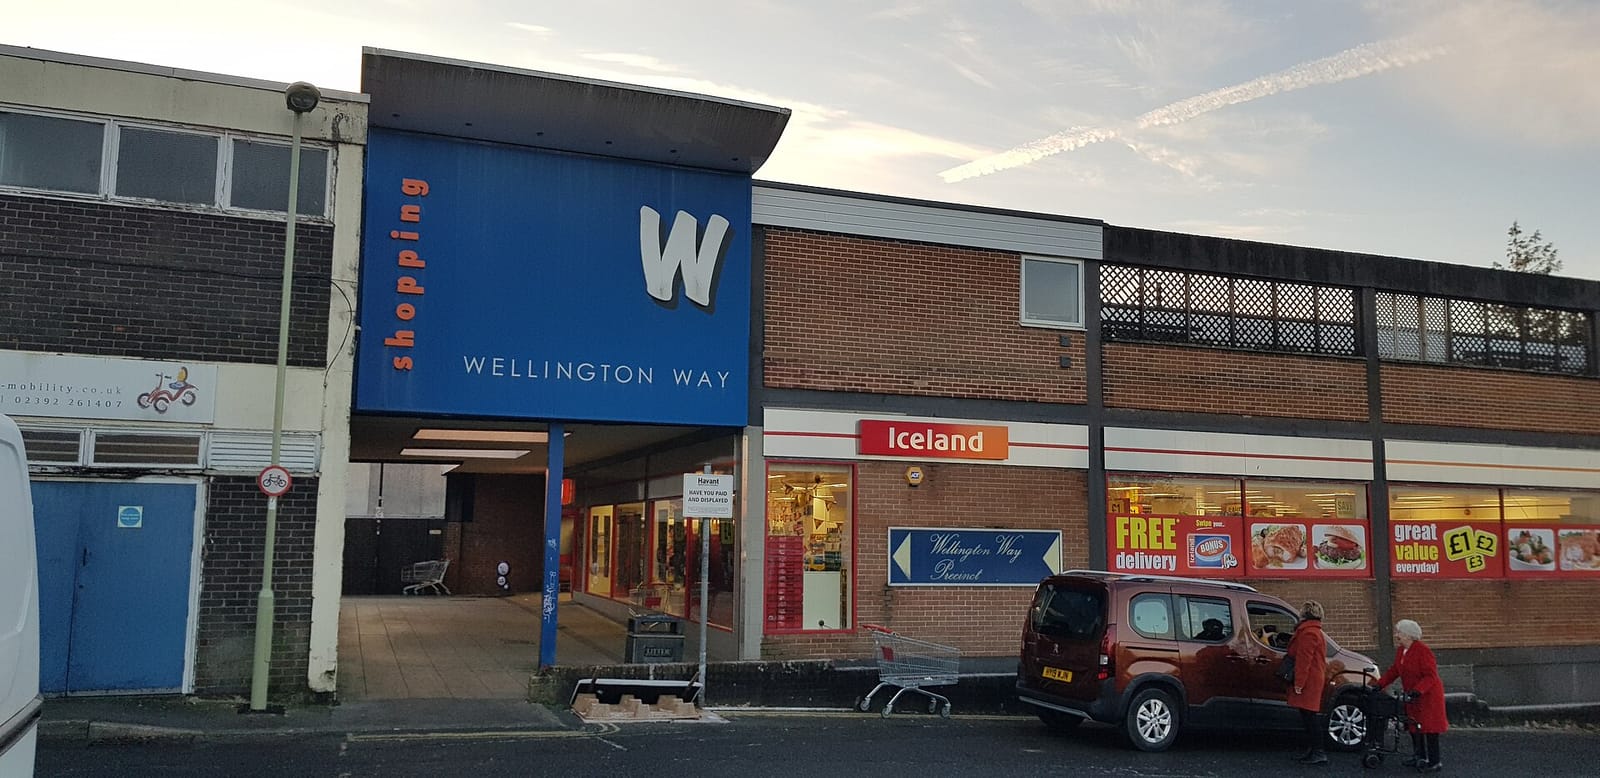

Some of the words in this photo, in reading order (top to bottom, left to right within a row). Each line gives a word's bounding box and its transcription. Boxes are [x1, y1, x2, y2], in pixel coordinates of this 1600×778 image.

[639, 205, 731, 308] W
[384, 177, 429, 371] shopping
[463, 355, 653, 385] WELLINGTON
[673, 367, 730, 389] WAY
[14, 396, 59, 406] 02392
[68, 398, 122, 408] 261407
[888, 427, 984, 452] Iceland
[1394, 523, 1438, 542] great
[1449, 531, 1471, 555] £1
[930, 533, 991, 563] Wellington
[995, 534, 1024, 564] Way
[1200, 540, 1224, 553] BONUS
[1395, 542, 1439, 561] value
[1476, 535, 1494, 552] £2
[930, 558, 983, 581] Precinct
[1116, 551, 1177, 572] delivery
[1396, 562, 1440, 574] everyday!
[1469, 555, 1483, 569] £3
